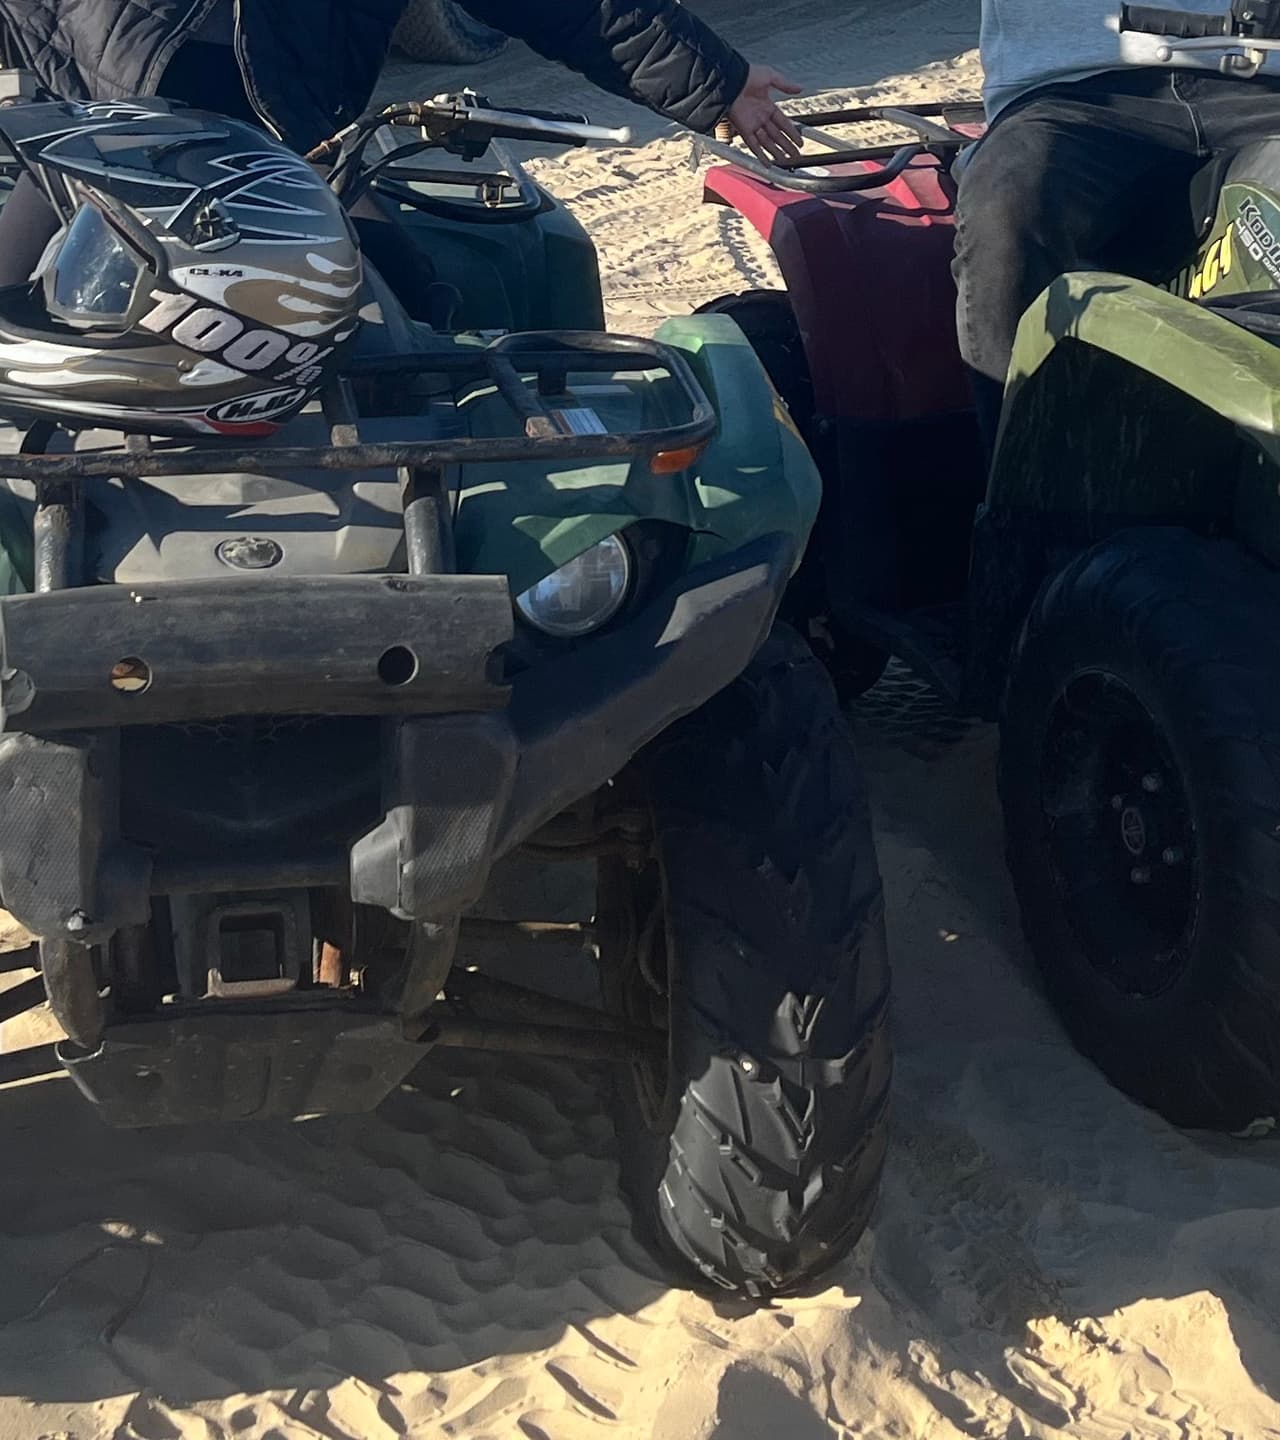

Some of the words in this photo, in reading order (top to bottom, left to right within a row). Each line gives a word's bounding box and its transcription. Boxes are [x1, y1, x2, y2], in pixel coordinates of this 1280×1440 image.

[1236, 217, 1263, 261] 450
[138, 289, 334, 385] 100%
[223, 392, 298, 419] HJC
